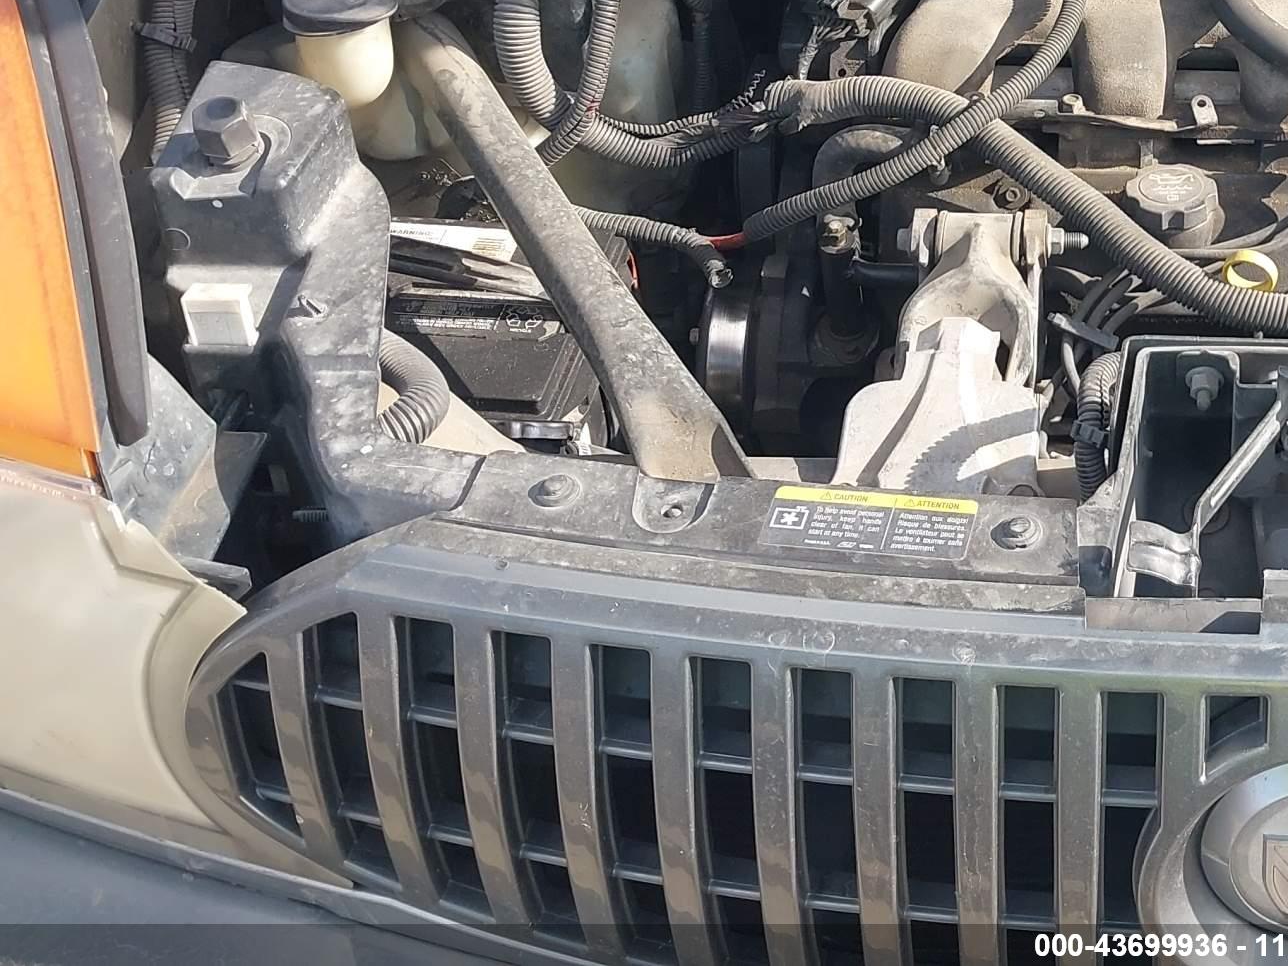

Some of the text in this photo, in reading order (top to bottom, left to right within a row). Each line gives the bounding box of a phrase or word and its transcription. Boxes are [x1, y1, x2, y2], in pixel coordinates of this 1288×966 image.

[834, 494, 869, 502] CAUTION
[916, 501, 960, 509] ATTENTION
[840, 516, 856, 524] keep
[899, 512, 928, 521] Attention
